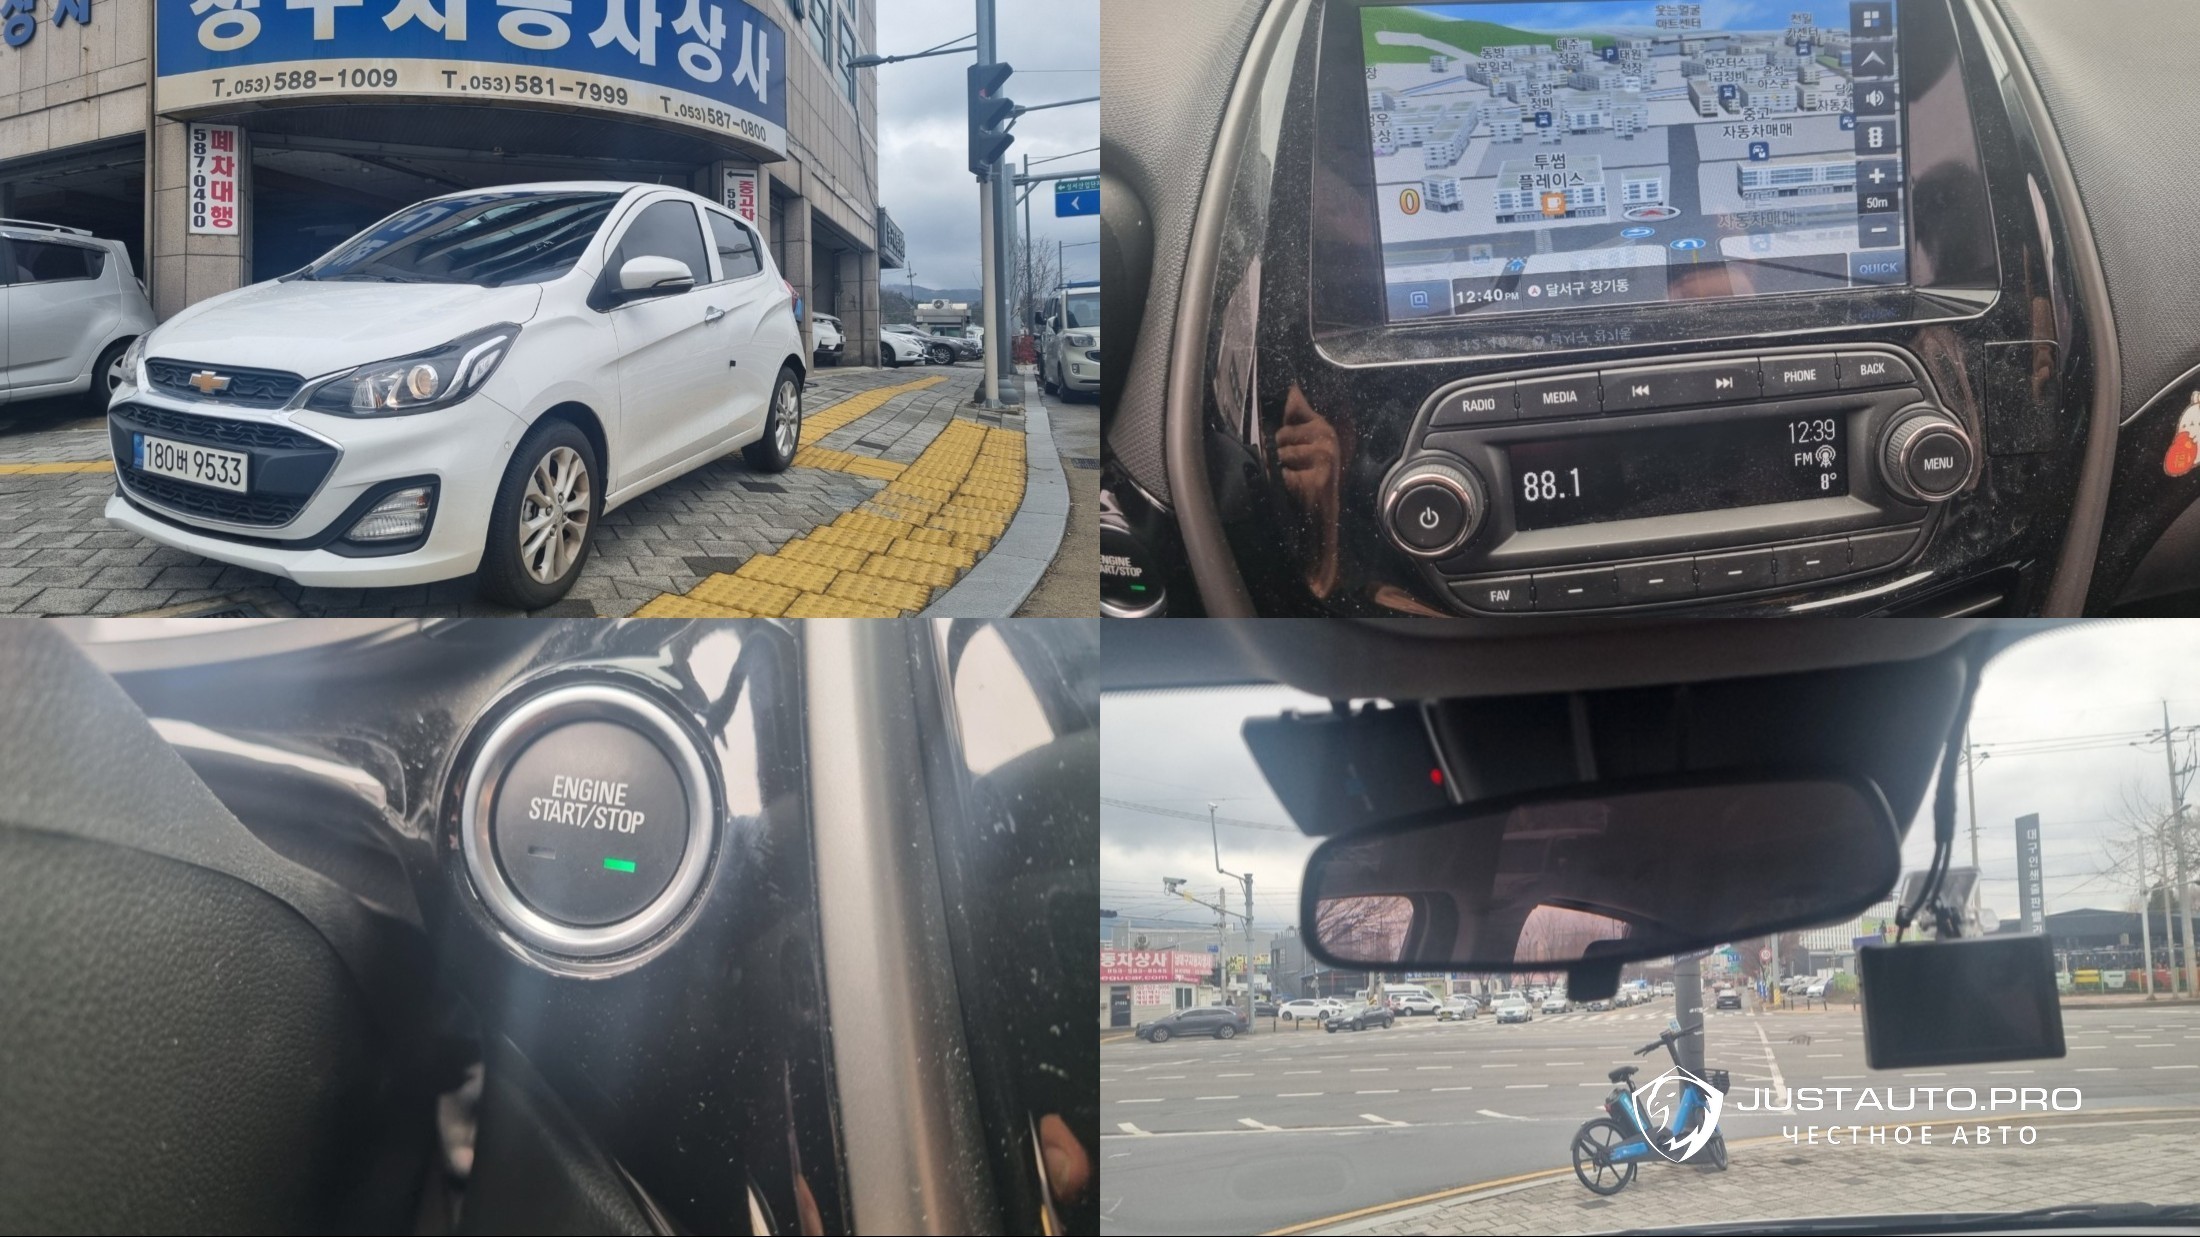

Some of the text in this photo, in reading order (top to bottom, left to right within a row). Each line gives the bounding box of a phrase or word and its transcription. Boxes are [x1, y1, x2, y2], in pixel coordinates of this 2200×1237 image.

[1482, 47, 1505, 59] 동방
[1477, 61, 1512, 73] 보일러
[1705, 57, 1748, 69] 한모터스
[1743, 108, 1771, 122] 중고
[1722, 123, 1793, 138] 자동차매매
[1533, 153, 1566, 171] 투썸
[210, 130, 235, 228] 폐차대행
[1518, 171, 1585, 191] 플레이스
[1400, 189, 1420, 215] 0
[1866, 197, 1888, 209] 50m
[1718, 210, 1796, 229] 자동차매매
[1860, 262, 1898, 274] QUICK
[1456, 288, 1519, 304] 12:40 PM
[1545, 278, 1630, 298] 달서구 장기동
[1783, 367, 1817, 383] PHONE
[1860, 361, 1885, 376] BACK
[1462, 398, 1496, 413] RADIO
[1542, 390, 1578, 405] MEDIA
[1787, 418, 1836, 445] 12:39
[146, 440, 242, 486] 180버 9533
[1794, 451, 1813, 467] FM
[1923, 456, 1954, 472] MENU
[1523, 467, 1582, 502] 88.1
[1820, 471, 1838, 491] 8°
[1490, 589, 1511, 604] FAV
[551, 774, 629, 807] ENGINE
[528, 796, 645, 834] START/STOP
[1100, 952, 1167, 968] 동차상사
